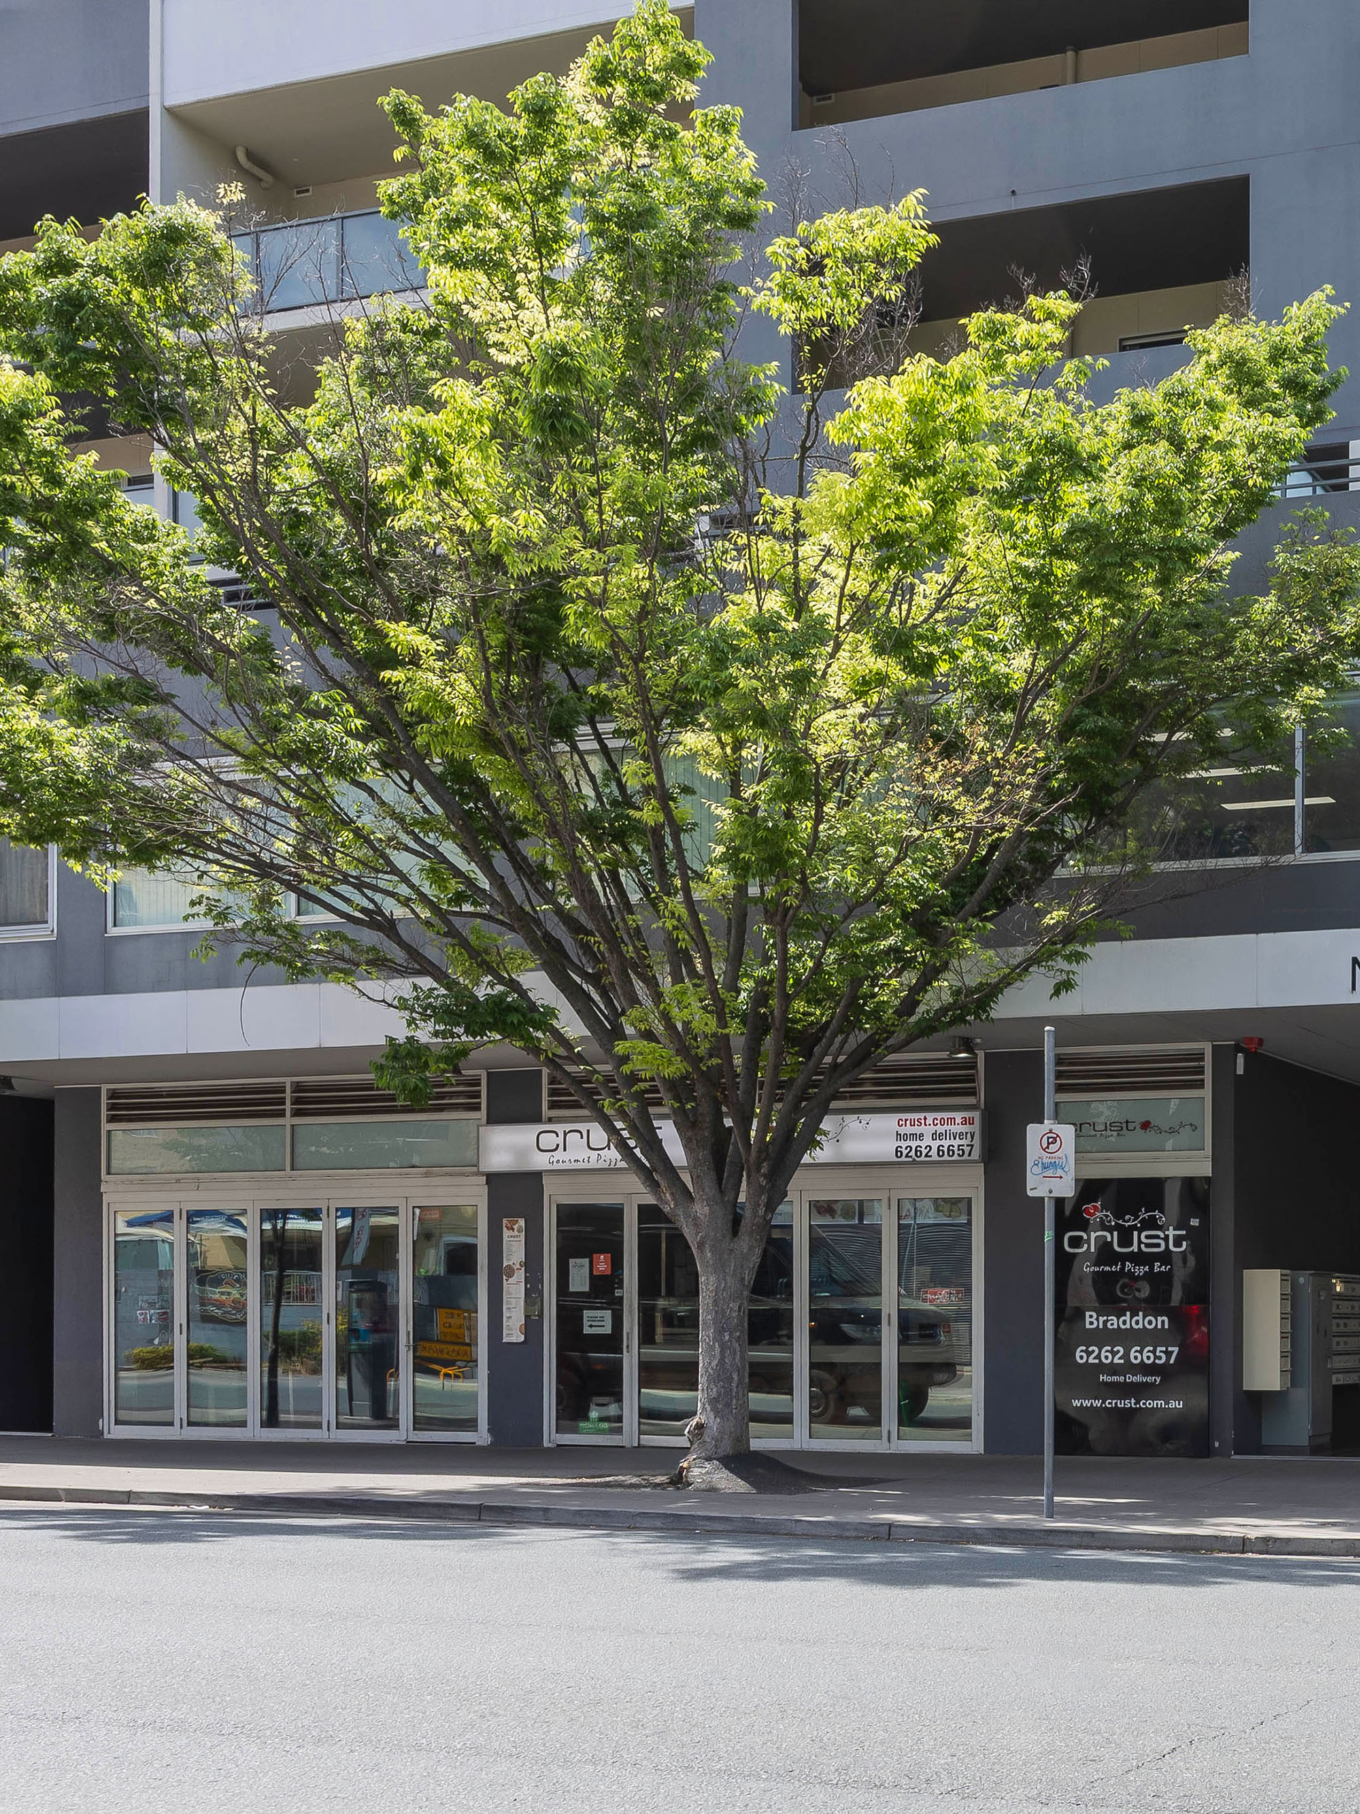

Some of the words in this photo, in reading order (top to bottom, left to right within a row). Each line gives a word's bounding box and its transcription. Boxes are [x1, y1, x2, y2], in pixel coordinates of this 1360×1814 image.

[897, 1115, 975, 1127] crust.com.au
[536, 1126, 662, 1152] cru
[896, 1130, 925, 1142] home
[931, 1129, 976, 1143] delivery
[895, 1145, 933, 1159] 6262
[937, 1144, 975, 1158] 6657
[548, 1155, 591, 1165] Gourmet
[597, 1153, 622, 1167] Pizz
[1063, 1226, 1187, 1253] crust
[1083, 1261, 1121, 1273] Gourmet
[1124, 1261, 1149, 1275] Pizza
[1153, 1261, 1171, 1273] Bar
[1085, 1311, 1169, 1329] Braddon
[1075, 1345, 1125, 1364] 6262
[1129, 1345, 1180, 1364] 6657
[1100, 1373, 1125, 1383] Home
[1126, 1373, 1161, 1385] Delivery
[1071, 1398, 1184, 1409] www.crust.com.au
